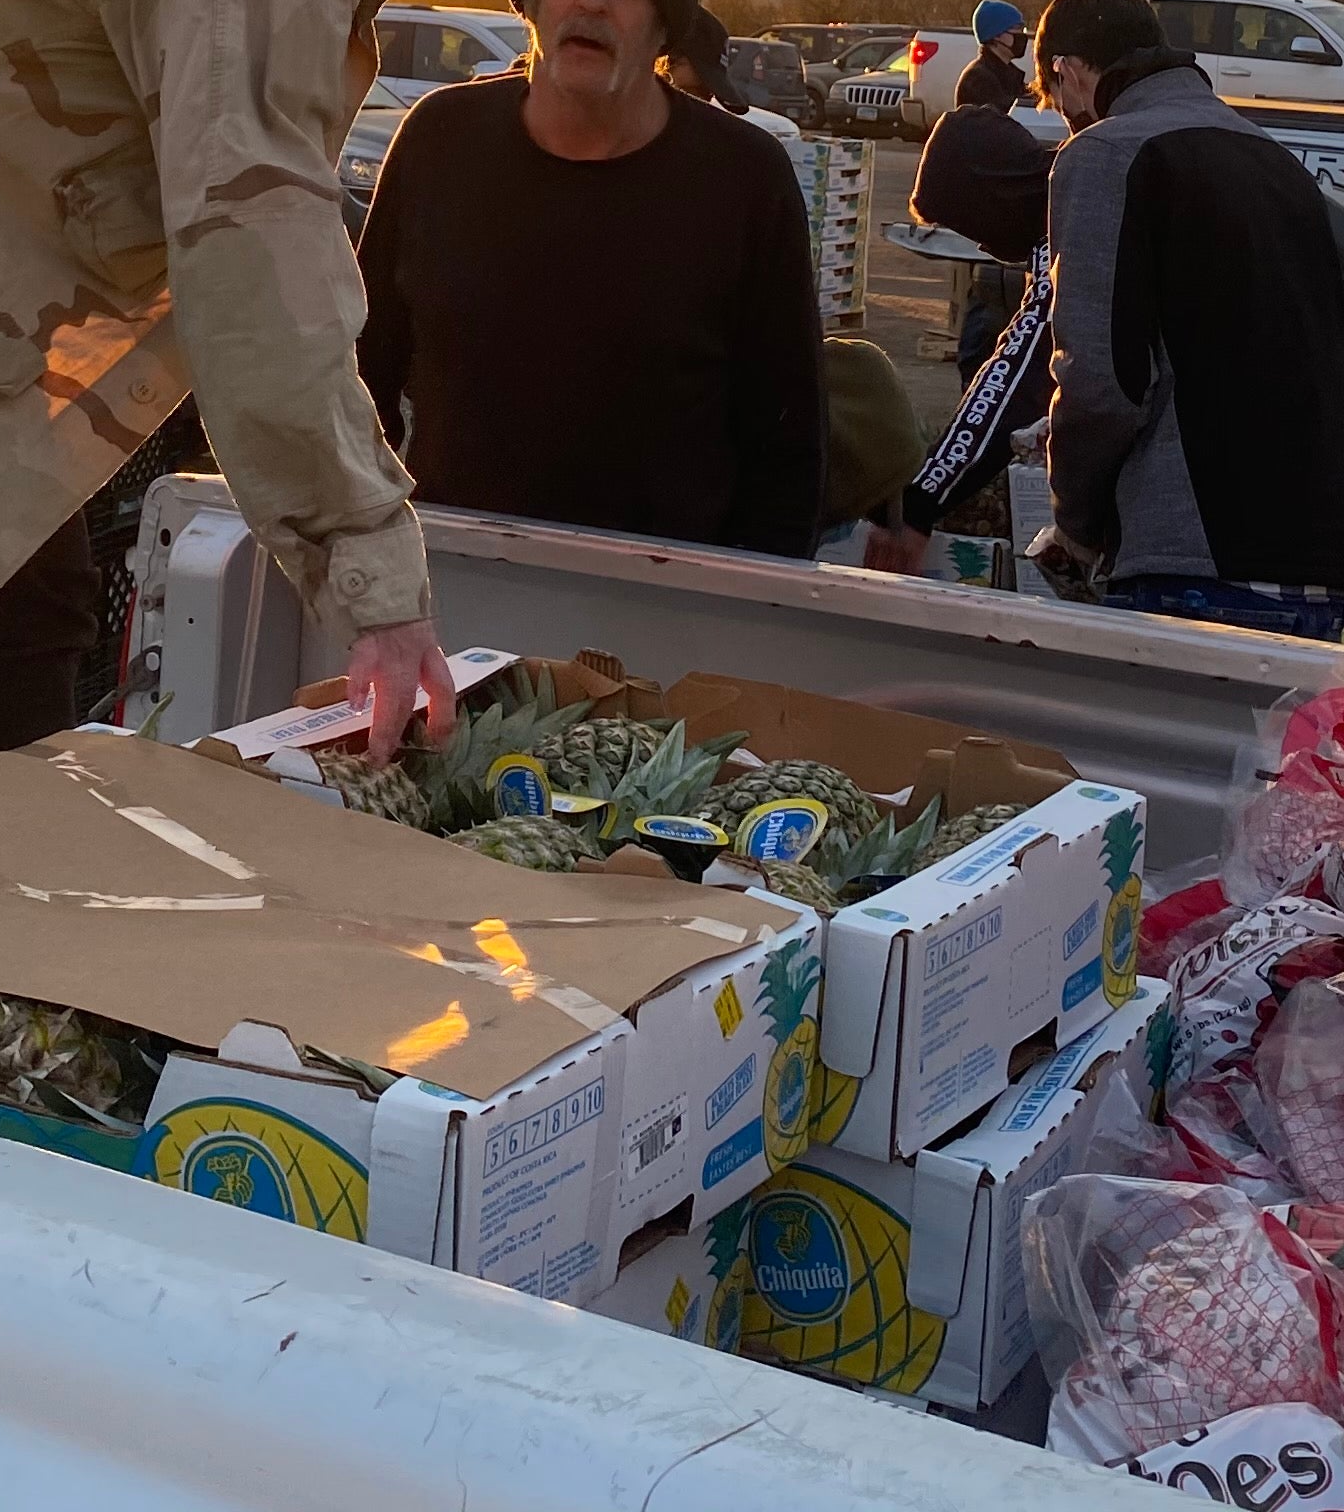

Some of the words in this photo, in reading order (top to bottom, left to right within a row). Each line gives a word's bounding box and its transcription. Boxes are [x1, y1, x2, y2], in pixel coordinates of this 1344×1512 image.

[966, 359, 1011, 426] adidas
[927, 950, 937, 974] 5
[941, 944, 949, 966] 6
[967, 928, 974, 950] 8
[979, 920, 986, 944] 9
[990, 912, 1001, 937] 10
[1184, 1029, 1193, 1039] 5
[489, 1141, 499, 1169] 5
[508, 1128, 518, 1155] 6
[531, 1118, 541, 1146] 7
[551, 1108, 561, 1134] 8
[571, 1097, 580, 1124] 9
[587, 1085, 602, 1114] 10
[757, 1262, 845, 1298] Chiquita
